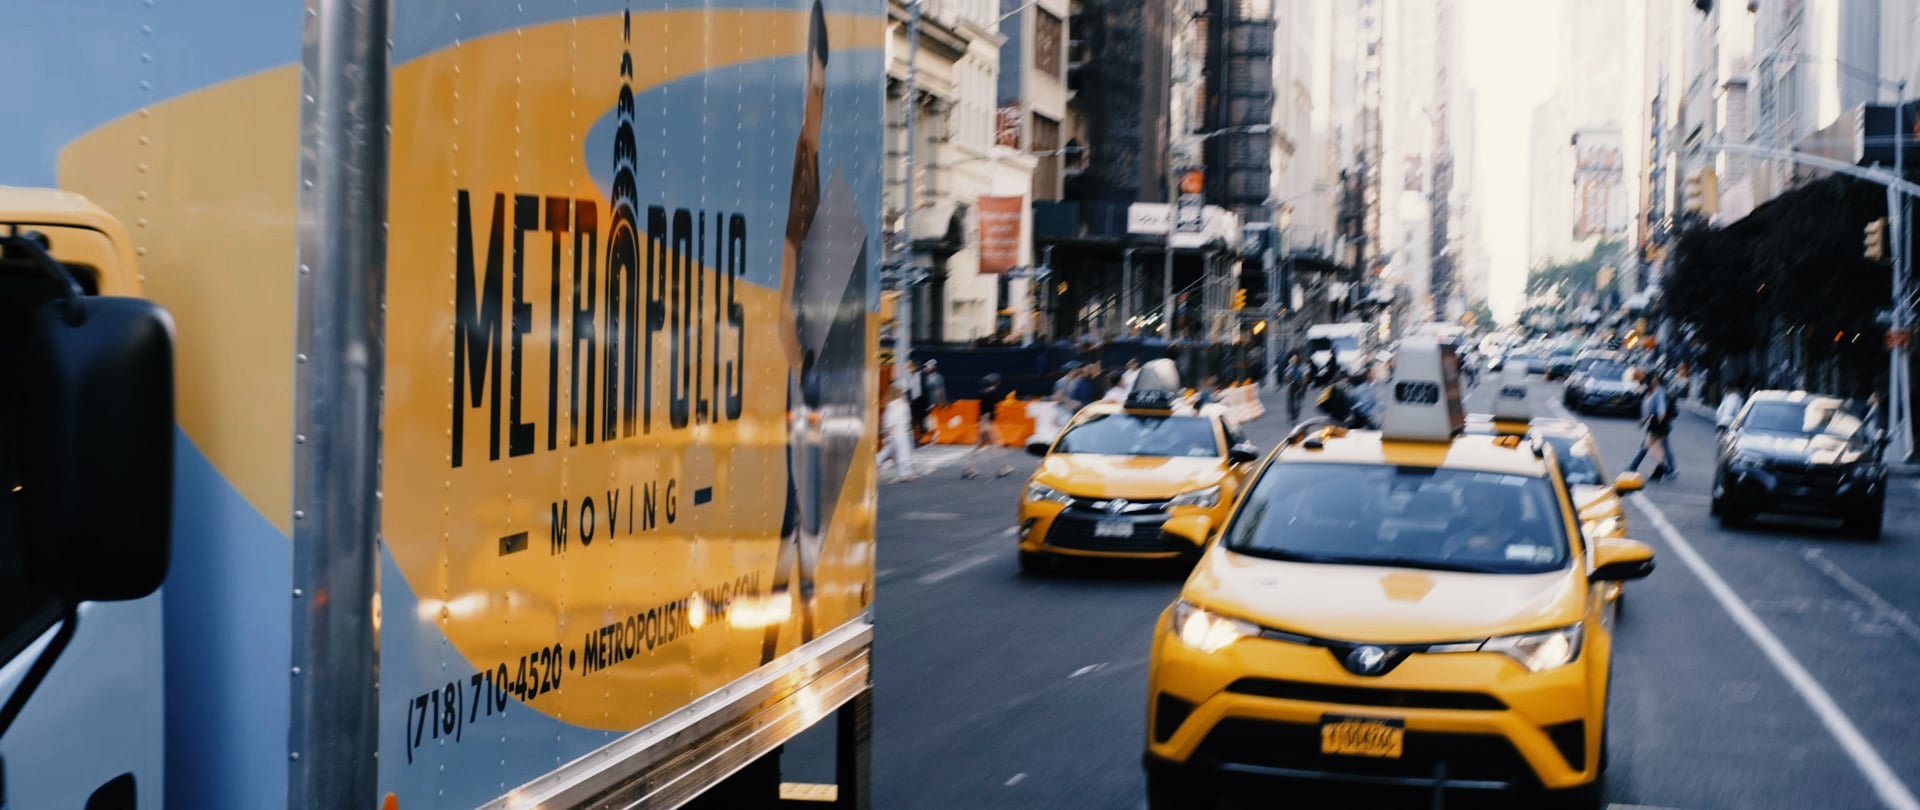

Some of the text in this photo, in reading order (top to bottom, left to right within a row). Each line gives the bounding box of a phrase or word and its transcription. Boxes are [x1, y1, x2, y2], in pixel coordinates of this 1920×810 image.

[451, 189, 747, 469] METROPOLIS
[550, 478, 677, 556] MOVING
[406, 679, 463, 764] (718)
[469, 642, 563, 724] 710-4520
